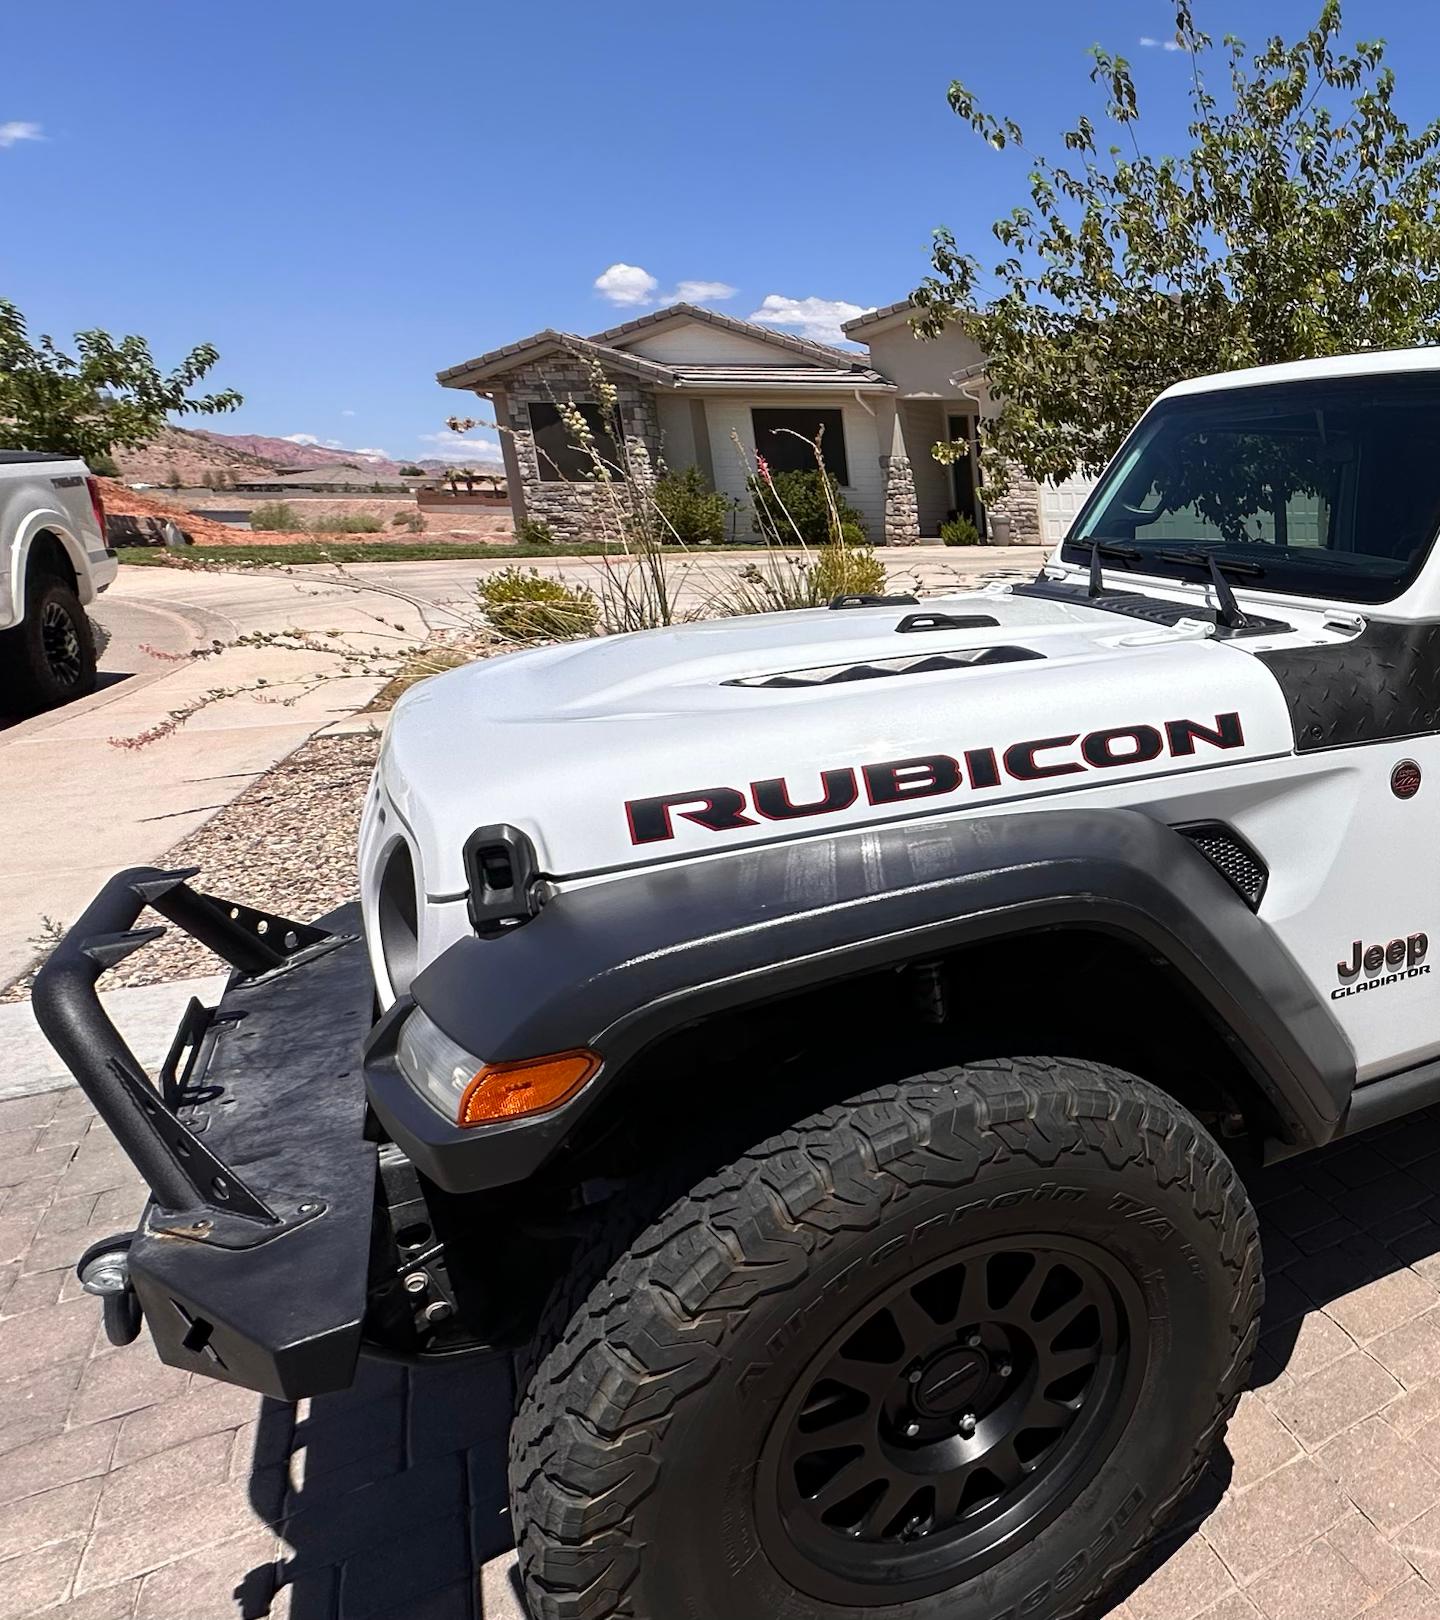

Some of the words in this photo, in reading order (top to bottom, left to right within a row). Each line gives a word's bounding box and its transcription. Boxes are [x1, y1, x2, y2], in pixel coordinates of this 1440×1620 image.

[625, 712, 1246, 845] RUBICON
[1337, 933, 1428, 977] Jeep
[1331, 965, 1431, 1000] GLADIATOR
